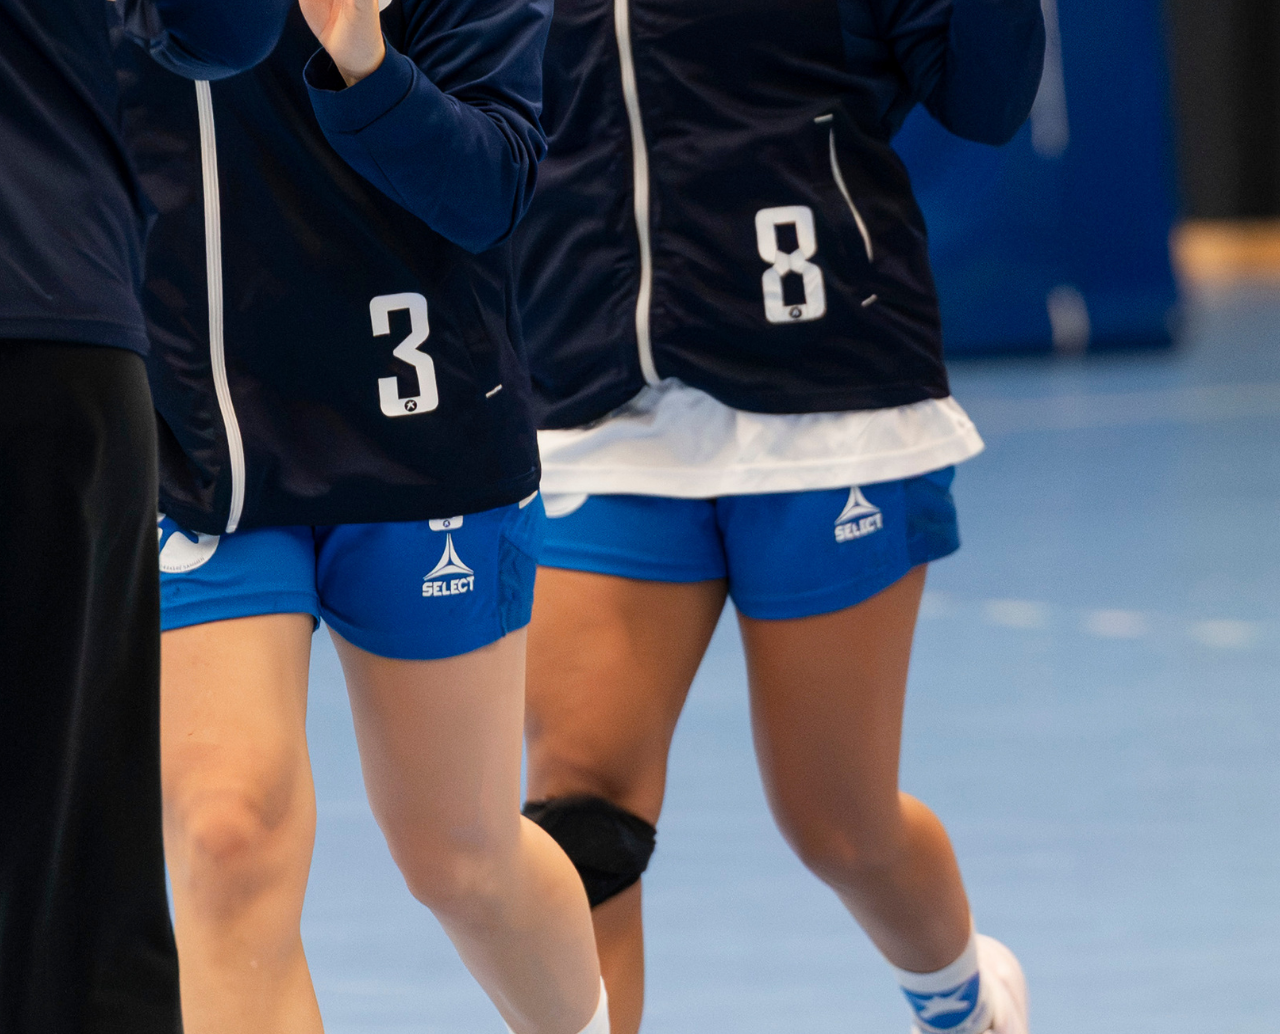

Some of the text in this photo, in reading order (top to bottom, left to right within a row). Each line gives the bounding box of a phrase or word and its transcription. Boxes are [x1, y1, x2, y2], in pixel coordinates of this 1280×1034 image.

[755, 205, 826, 324] 8
[370, 292, 439, 417] 3
[834, 512, 883, 543] SELECT
[422, 575, 475, 597] SELECT
